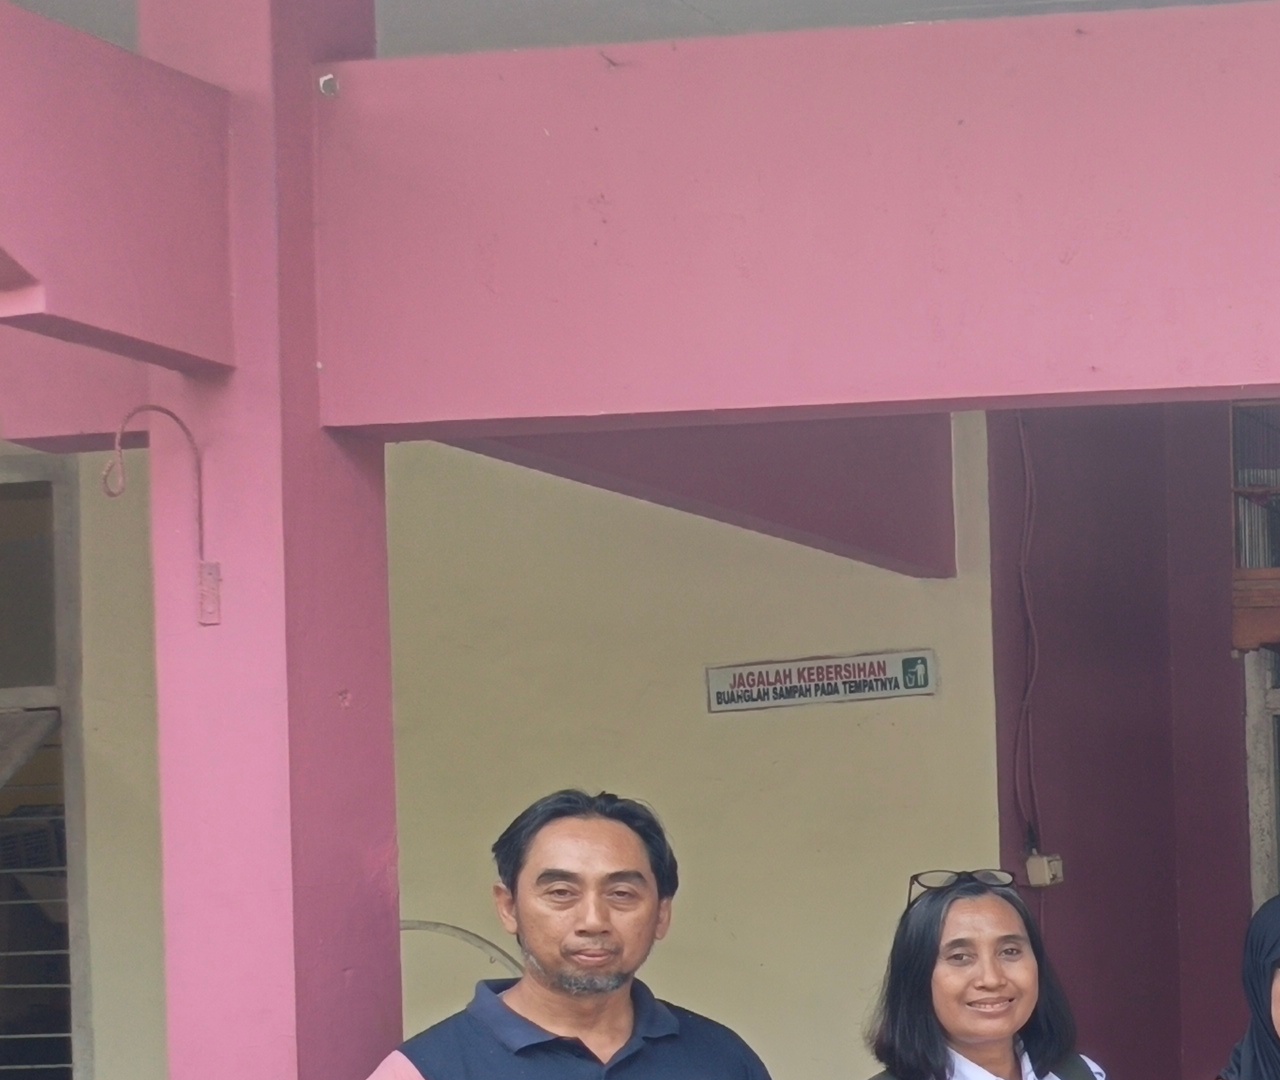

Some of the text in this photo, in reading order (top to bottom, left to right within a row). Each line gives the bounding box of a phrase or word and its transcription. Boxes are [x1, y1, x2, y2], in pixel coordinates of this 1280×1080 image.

[729, 660, 887, 690] JAGALAH KEBERSIHAN
[772, 684, 812, 701] SAMPAH
[814, 682, 840, 698] PADA
[841, 676, 901, 695] TEMPATNYA
